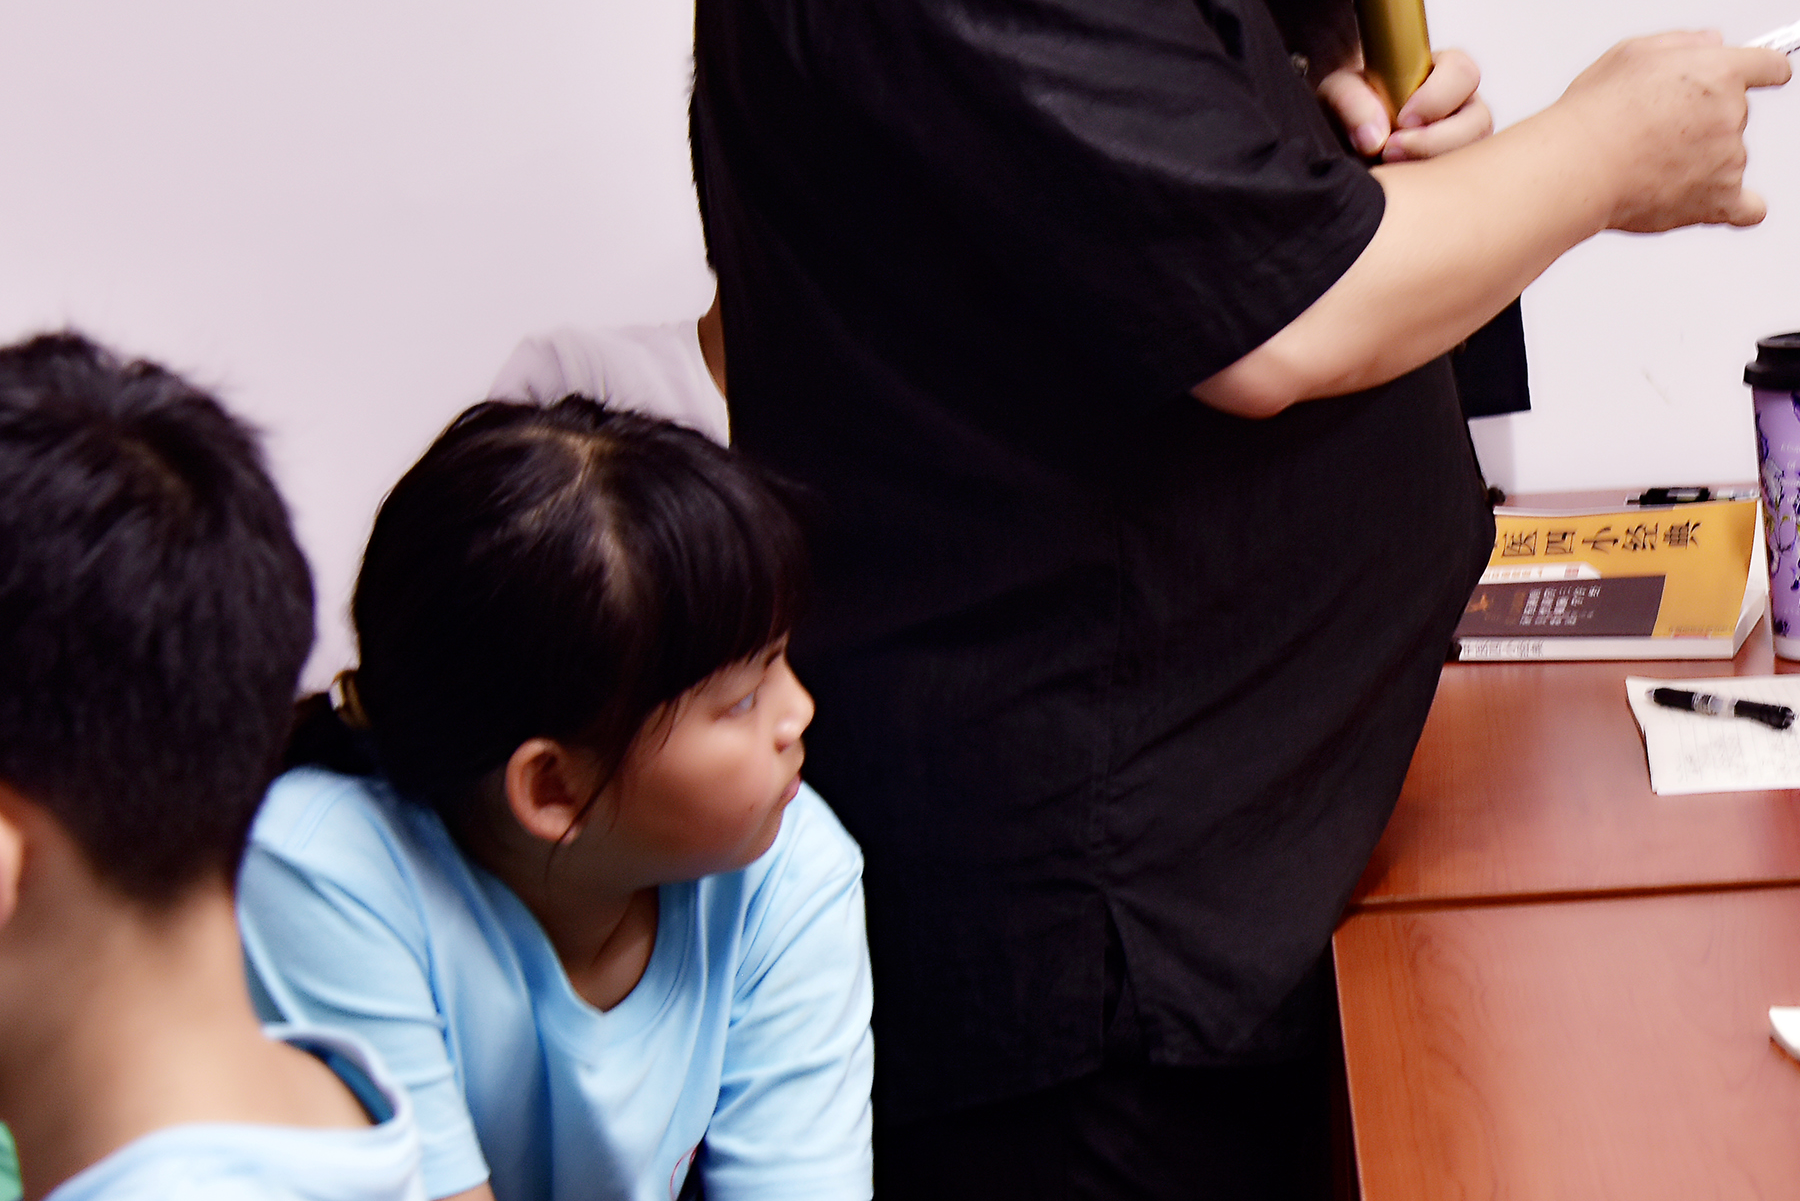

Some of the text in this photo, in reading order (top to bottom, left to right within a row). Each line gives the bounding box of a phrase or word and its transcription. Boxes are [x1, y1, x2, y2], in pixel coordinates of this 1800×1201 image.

[1494, 521, 1701, 558] 医四小经典
